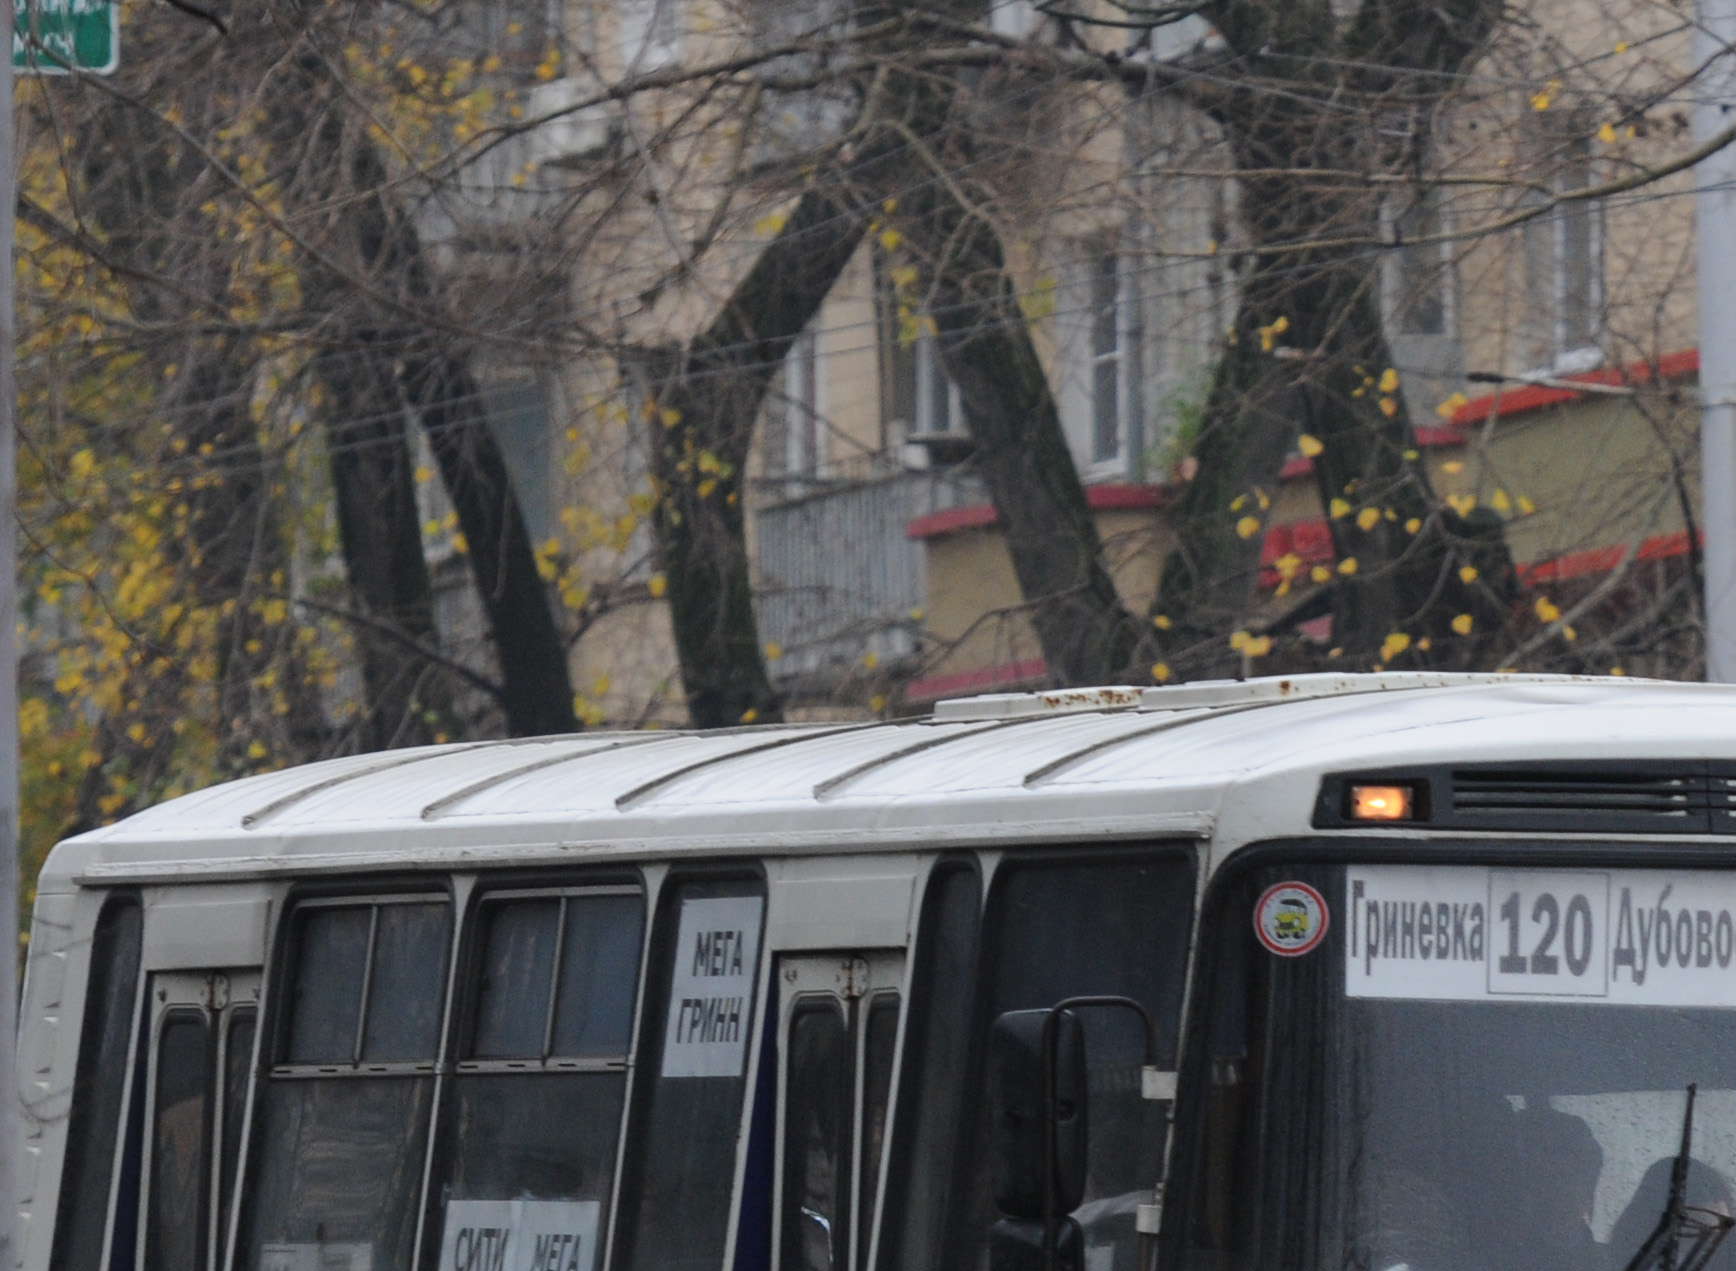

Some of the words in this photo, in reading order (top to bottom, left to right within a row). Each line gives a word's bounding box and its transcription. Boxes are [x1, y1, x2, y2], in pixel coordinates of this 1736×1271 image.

[1351, 879, 1485, 976] Гриневка
[1499, 891, 1594, 978] 120
[692, 930, 743, 977] МЕГА
[676, 997, 743, 1044] ГРИНН
